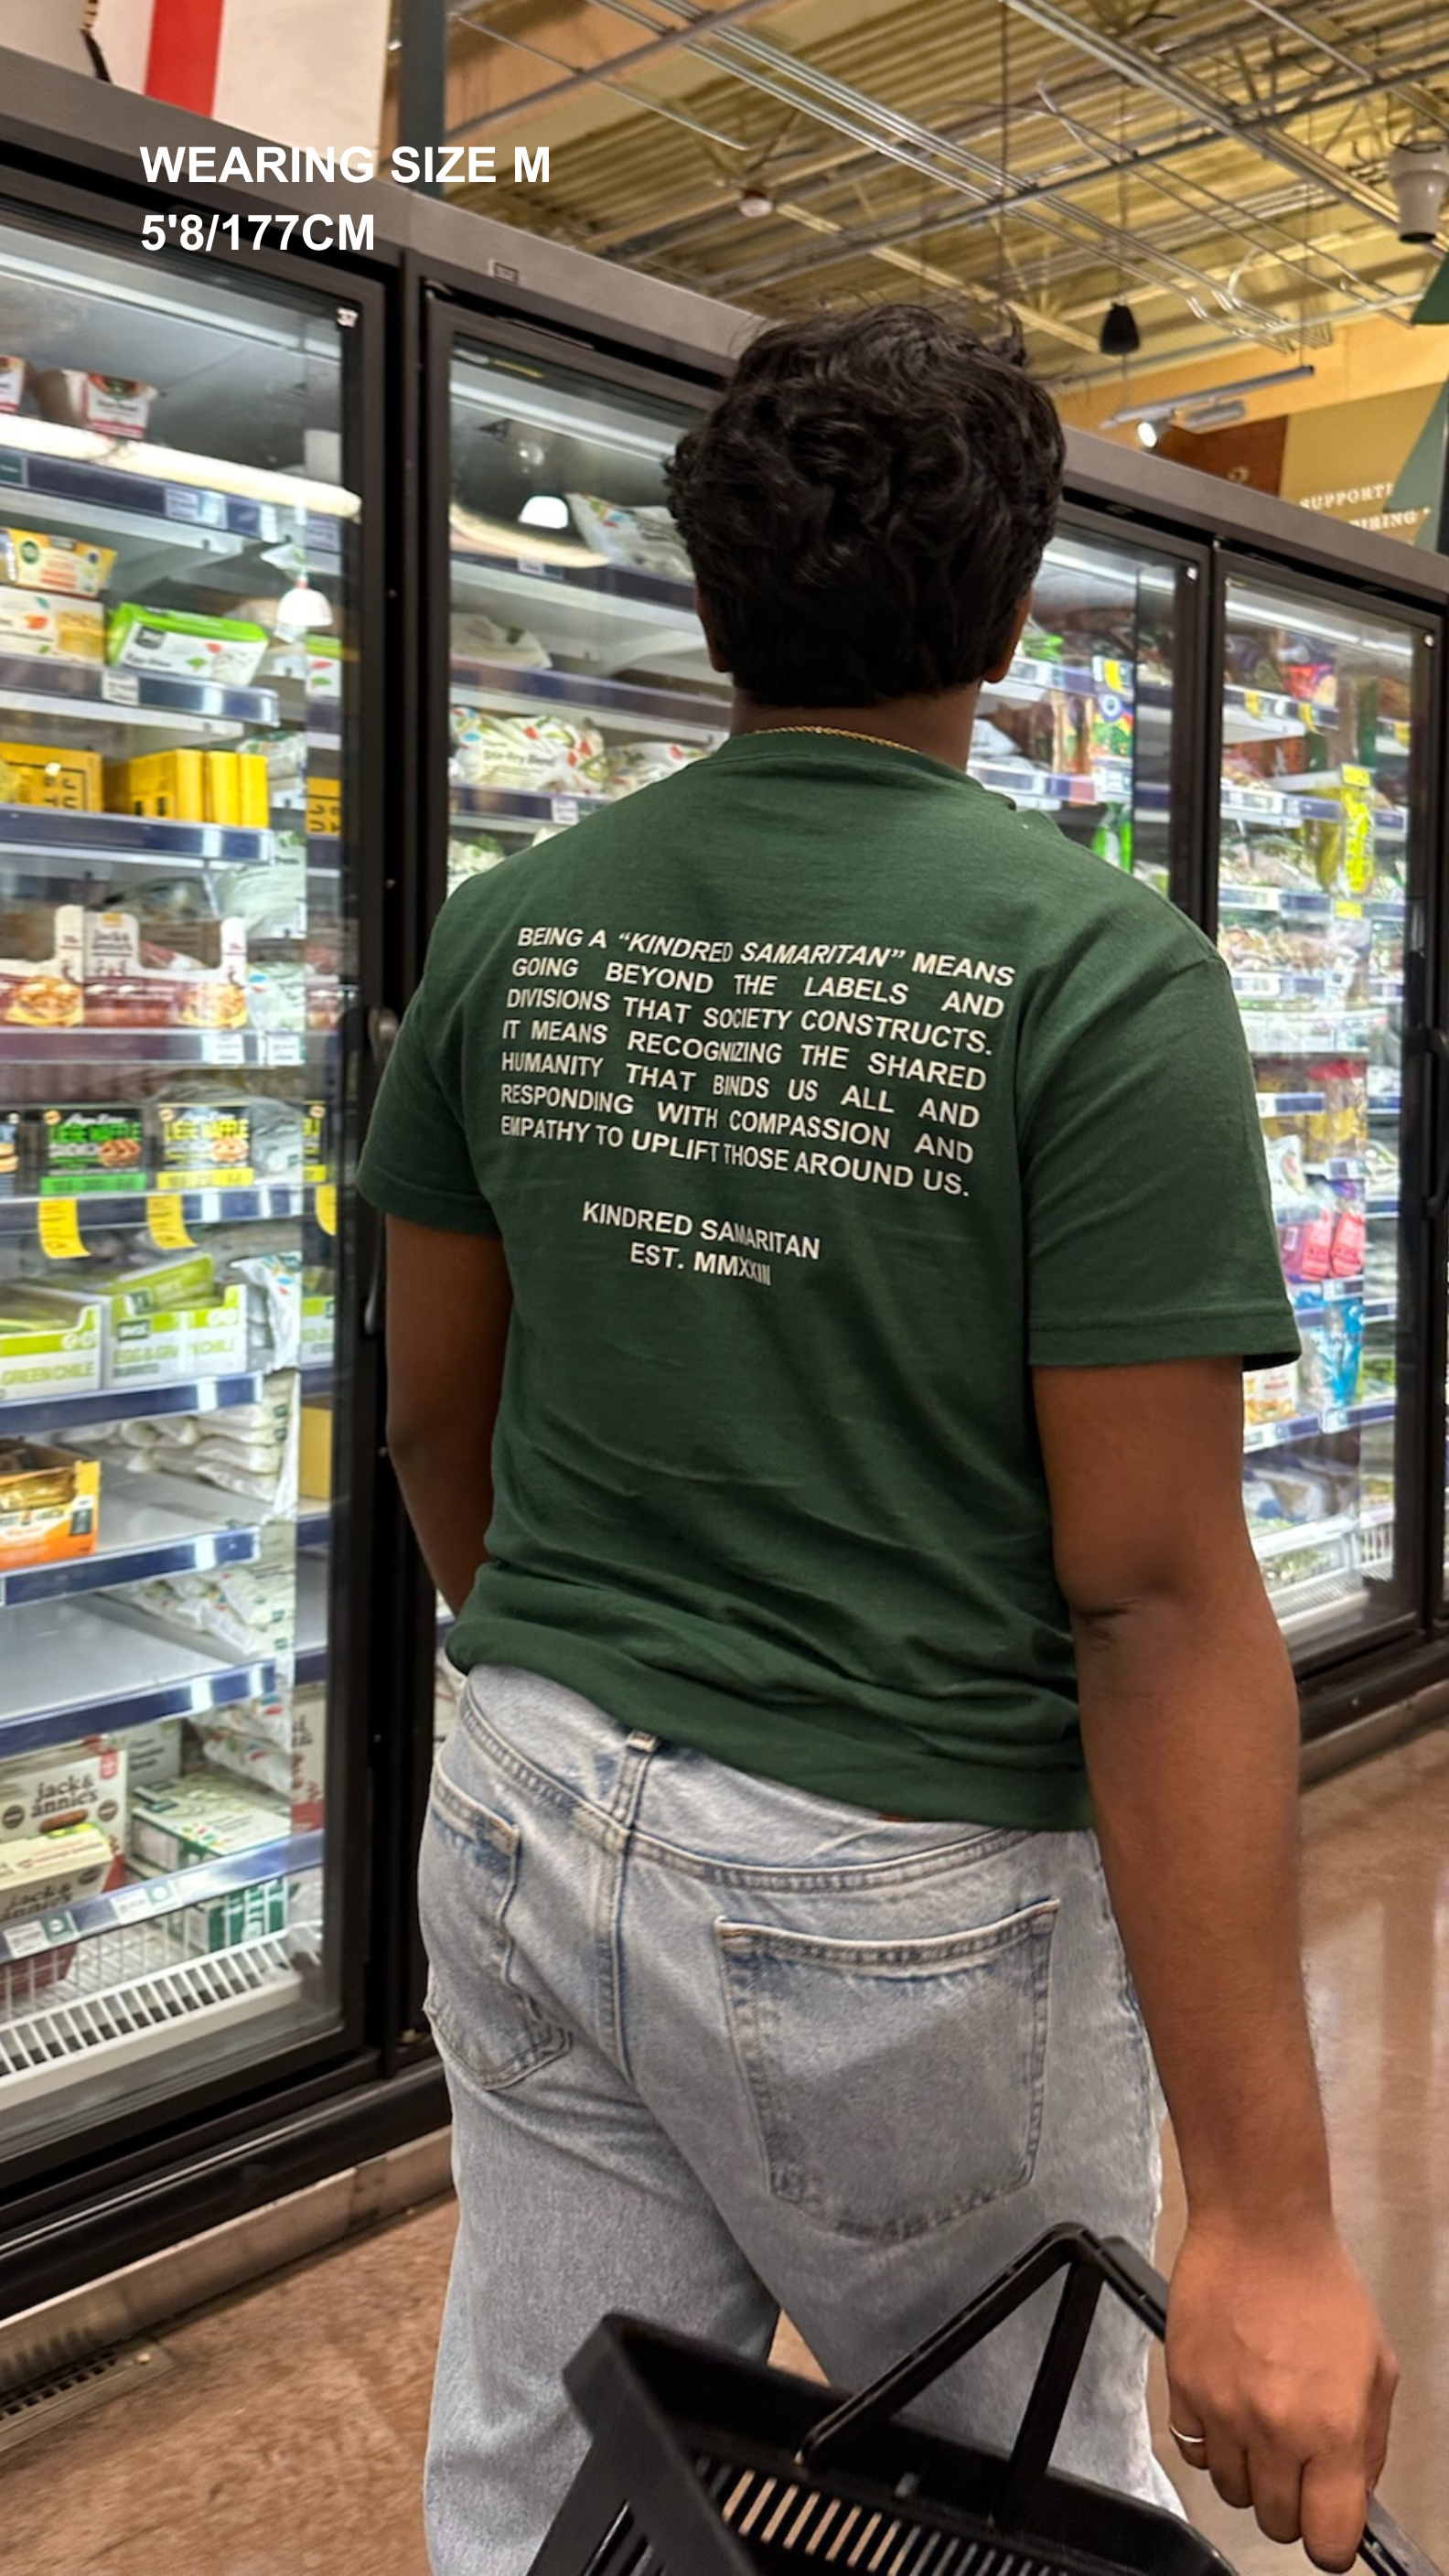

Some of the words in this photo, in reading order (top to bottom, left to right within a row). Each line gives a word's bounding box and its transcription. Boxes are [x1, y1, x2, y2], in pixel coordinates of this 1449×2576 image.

[512, 958, 579, 977] GOING
[605, 962, 714, 994] BEYOND
[735, 974, 778, 996] THE
[803, 977, 908, 1005] LABELS
[941, 992, 1004, 1019] AND
[517, 927, 584, 947] BEING
[588, 929, 607, 949] A
[618, 931, 734, 963] “KINDRED
[740, 941, 906, 968] SAMARITAN”
[911, 952, 1015, 987] MEANS
[502, 1020, 521, 1039] IT
[531, 1020, 608, 1045] MEANS
[628, 1030, 782, 1064] RECOGNIZING
[800, 1044, 850, 1069] THE
[867, 1052, 987, 1091] SHARED
[507, 988, 611, 1012] DIVISIONS
[623, 996, 692, 1025] THAT
[703, 1007, 793, 1030] SOCIETY
[800, 1010, 993, 1056] CONSTRUCTS.
[501, 1052, 604, 1078] HUMANITY
[626, 1063, 696, 1091] THAT
[713, 1074, 769, 1099] BINDS
[788, 1079, 819, 1101] US
[841, 1085, 895, 1113] ALL
[918, 1098, 980, 1129] AND
[501, 1084, 634, 1114] RESPONDING
[657, 1101, 718, 1129] WITH
[729, 1109, 890, 1149] COMPASSION
[914, 1133, 974, 1165] AND
[501, 1115, 591, 1143] EMPATHY
[596, 1124, 624, 1147] TO
[631, 1129, 720, 1163] UPLIFT
[724, 1143, 789, 1171] THOSE
[794, 1151, 914, 1188] AROUND
[923, 1168, 970, 1197] US.
[583, 1201, 692, 1236] KINDRED
[700, 1219, 821, 1260] SAMARITAN
[630, 1242, 684, 1270] EST.
[693, 1251, 771, 1286] MMXXIII
